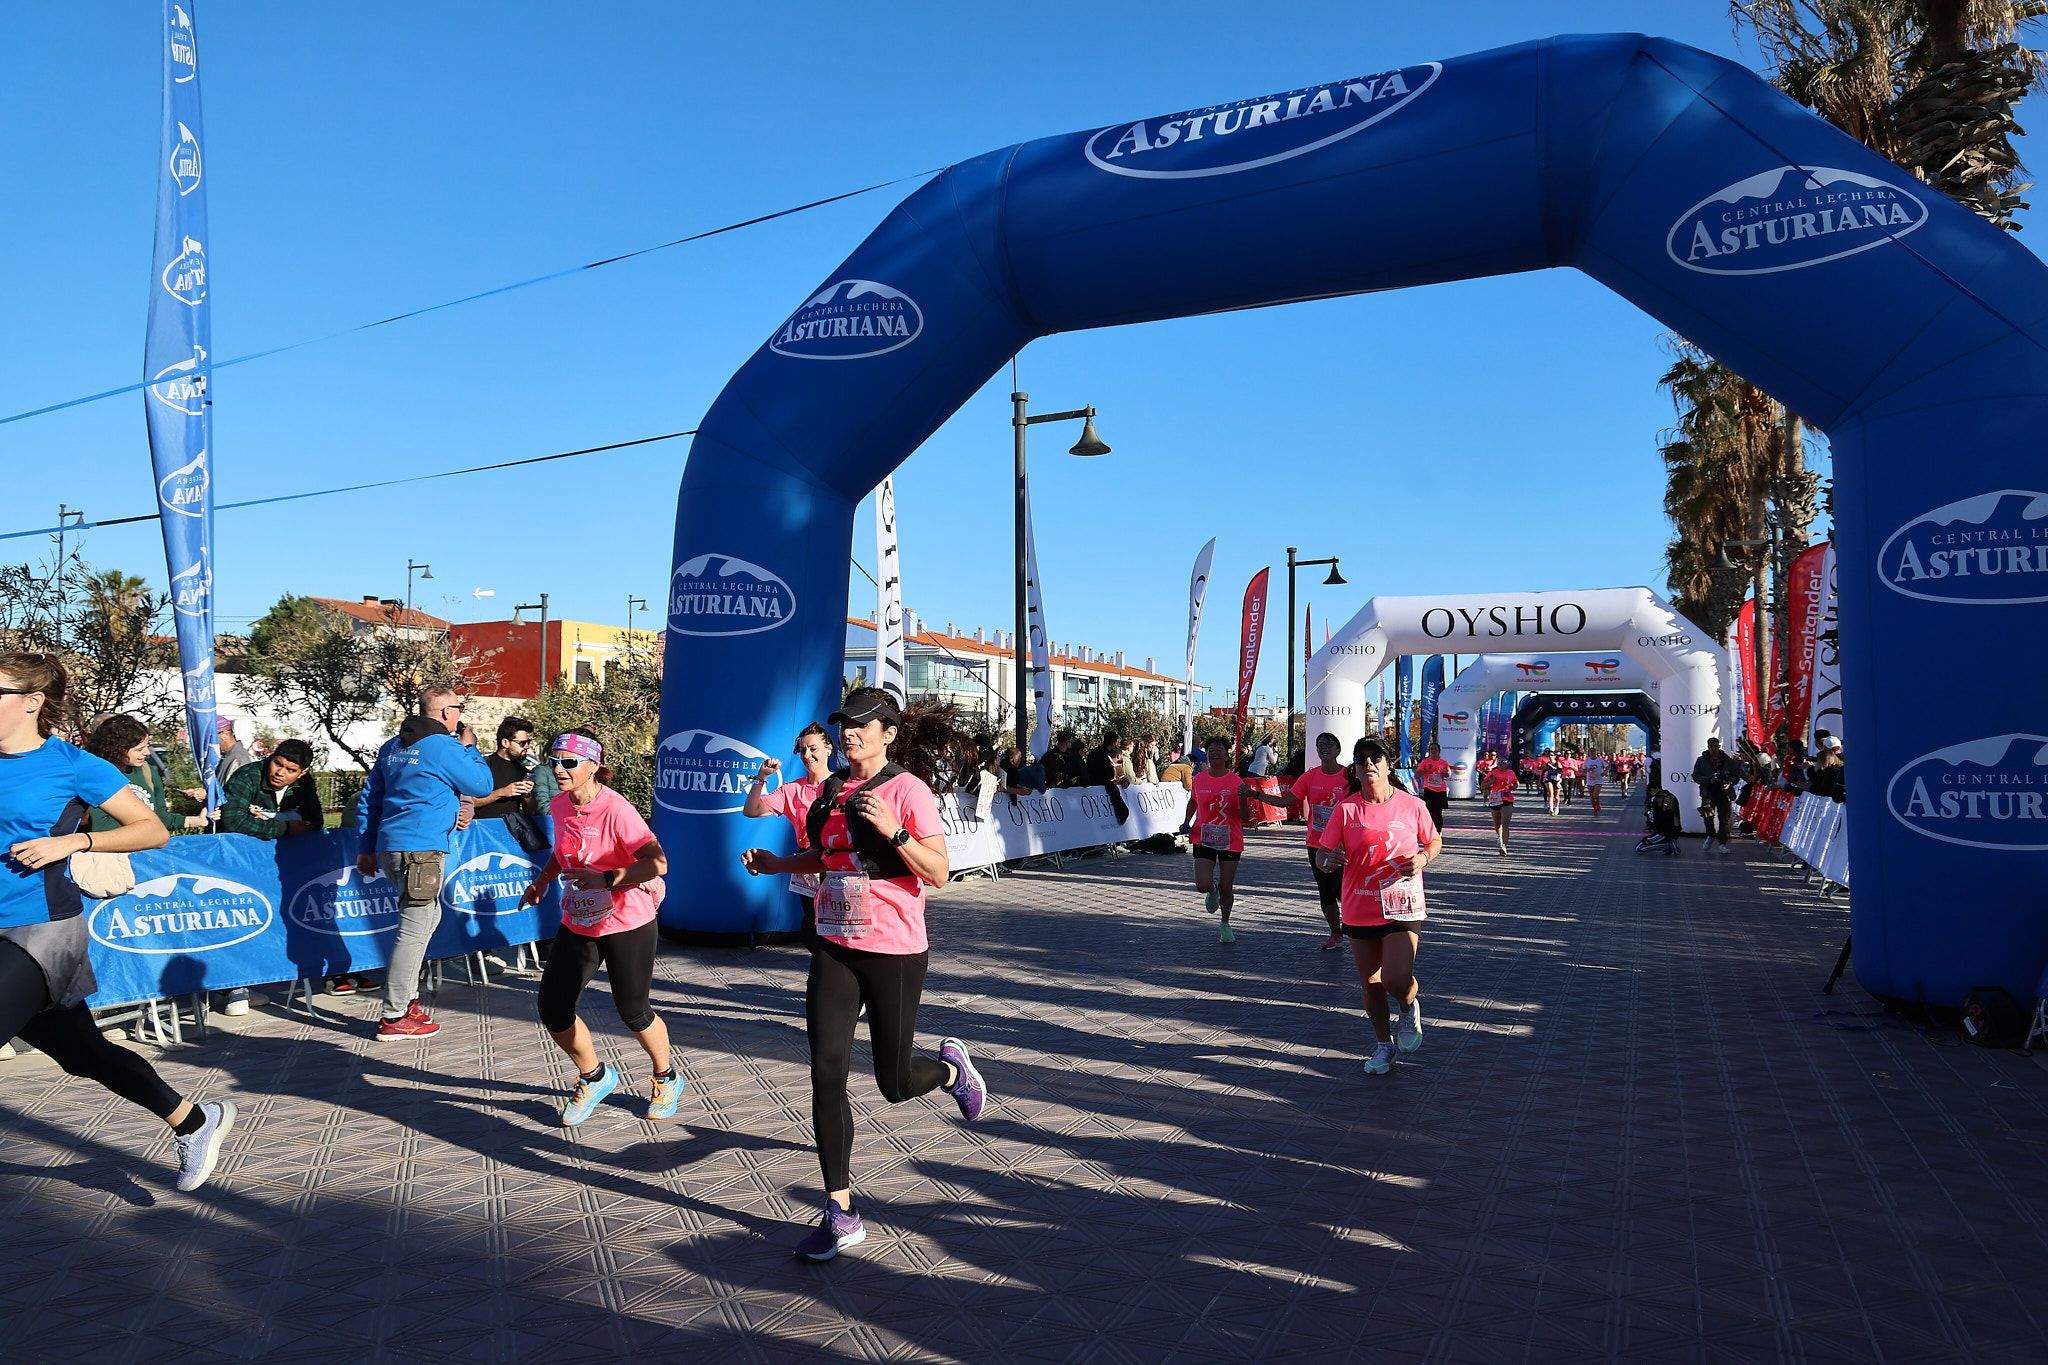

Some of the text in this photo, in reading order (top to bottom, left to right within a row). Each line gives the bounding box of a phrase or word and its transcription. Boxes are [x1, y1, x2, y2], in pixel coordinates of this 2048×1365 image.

[1105, 73, 1410, 159] ASTURIANA
[1722, 190, 1897, 223] CENTRAL LECHERA
[1687, 202, 1913, 262] ASTURIANA
[802, 302, 904, 320] CENTRAL LECHERA
[775, 314, 911, 346] ASTURIANA
[1932, 528, 2022, 545] CENTRAL
[678, 581, 779, 594] CENTRAL LECHERA
[668, 585, 783, 619] ASTURIANA
[1421, 604, 1587, 638] OYSHO
[1799, 570, 1823, 672] Santander
[1243, 596, 1260, 680] Santander
[1638, 635, 1692, 647] OYSHO
[1330, 645, 1376, 655] OYSHO
[1309, 705, 1351, 716] OYSHO
[1669, 704, 1721, 716] OYSHO
[664, 756, 704, 767] CENTRAL
[1942, 774, 2034, 784] CENTRAL
[1138, 788, 1176, 814] OYSHO
[1904, 776, 2048, 820] ASTUR
[940, 803, 979, 837] SHO
[1007, 796, 1064, 827] OYSHO
[468, 874, 501, 883] CENTRAL
[322, 888, 365, 899] CENTRAL
[134, 897, 254, 912] CENTRAL LECHERA
[574, 898, 596, 909] 016
[831, 900, 851, 911] 016
[106, 906, 264, 940] ASTURIANA
